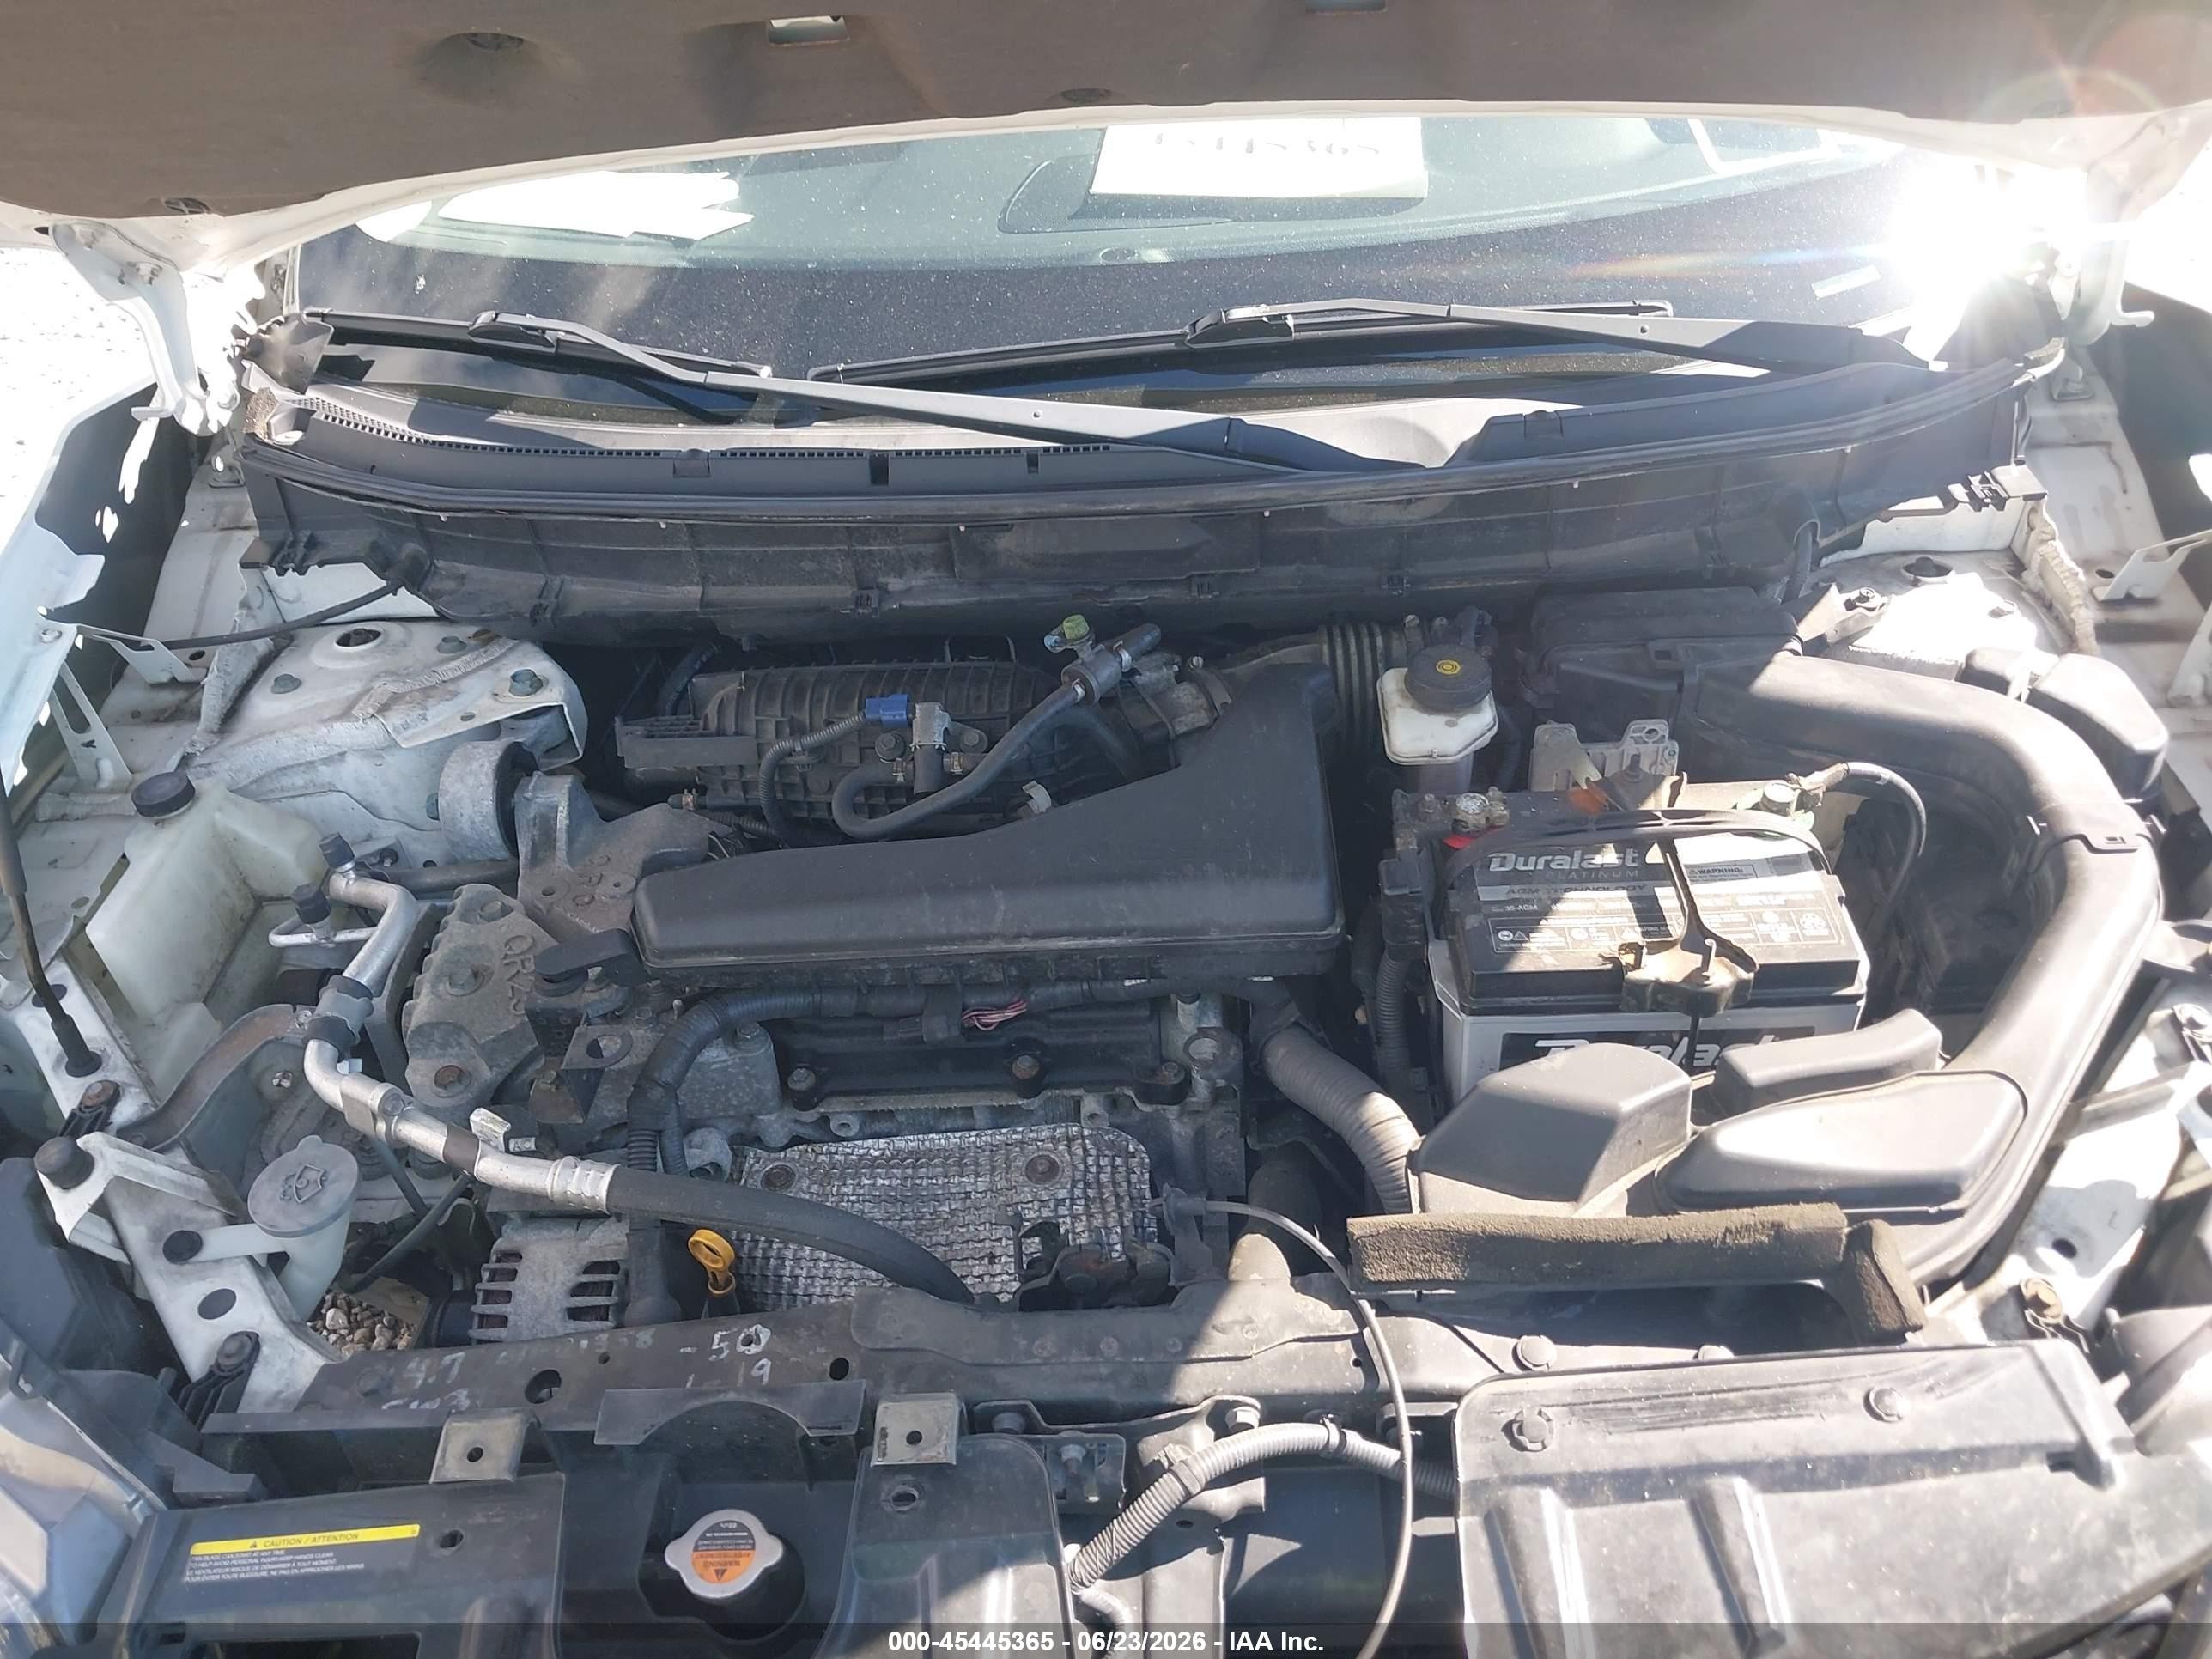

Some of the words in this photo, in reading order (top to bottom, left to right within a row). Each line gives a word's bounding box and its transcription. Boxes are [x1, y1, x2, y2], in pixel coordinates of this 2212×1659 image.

[1487, 848, 1638, 872] Duralast
[264, 1537, 302, 1548] CAUTION
[312, 1533, 359, 1544] ATTENTION
